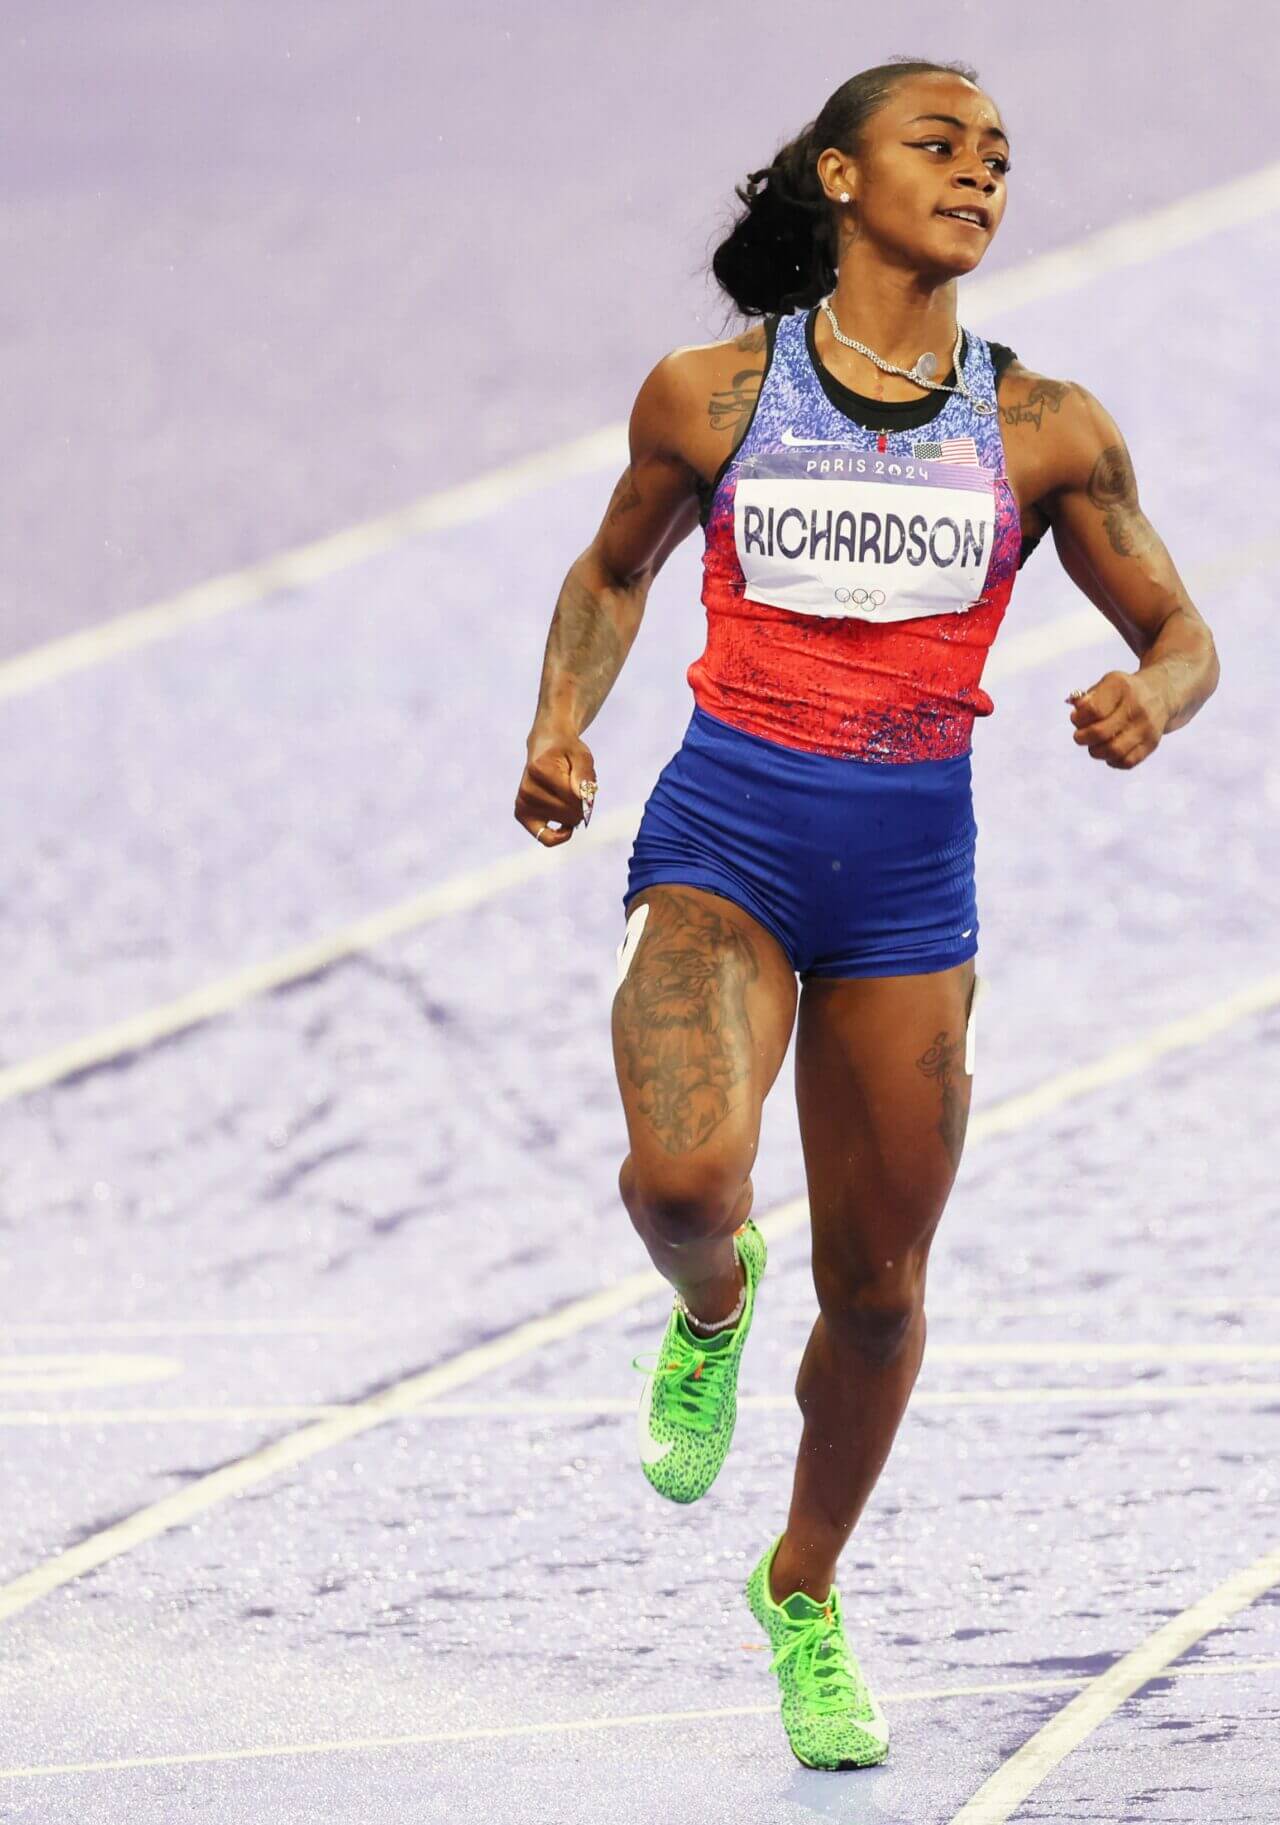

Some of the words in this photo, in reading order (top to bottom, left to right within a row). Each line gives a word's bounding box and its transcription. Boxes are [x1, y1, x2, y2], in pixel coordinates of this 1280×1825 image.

[806, 458, 867, 474] PARIS
[874, 460, 929, 481] 2024
[744, 505, 986, 568] RICHARDSON
